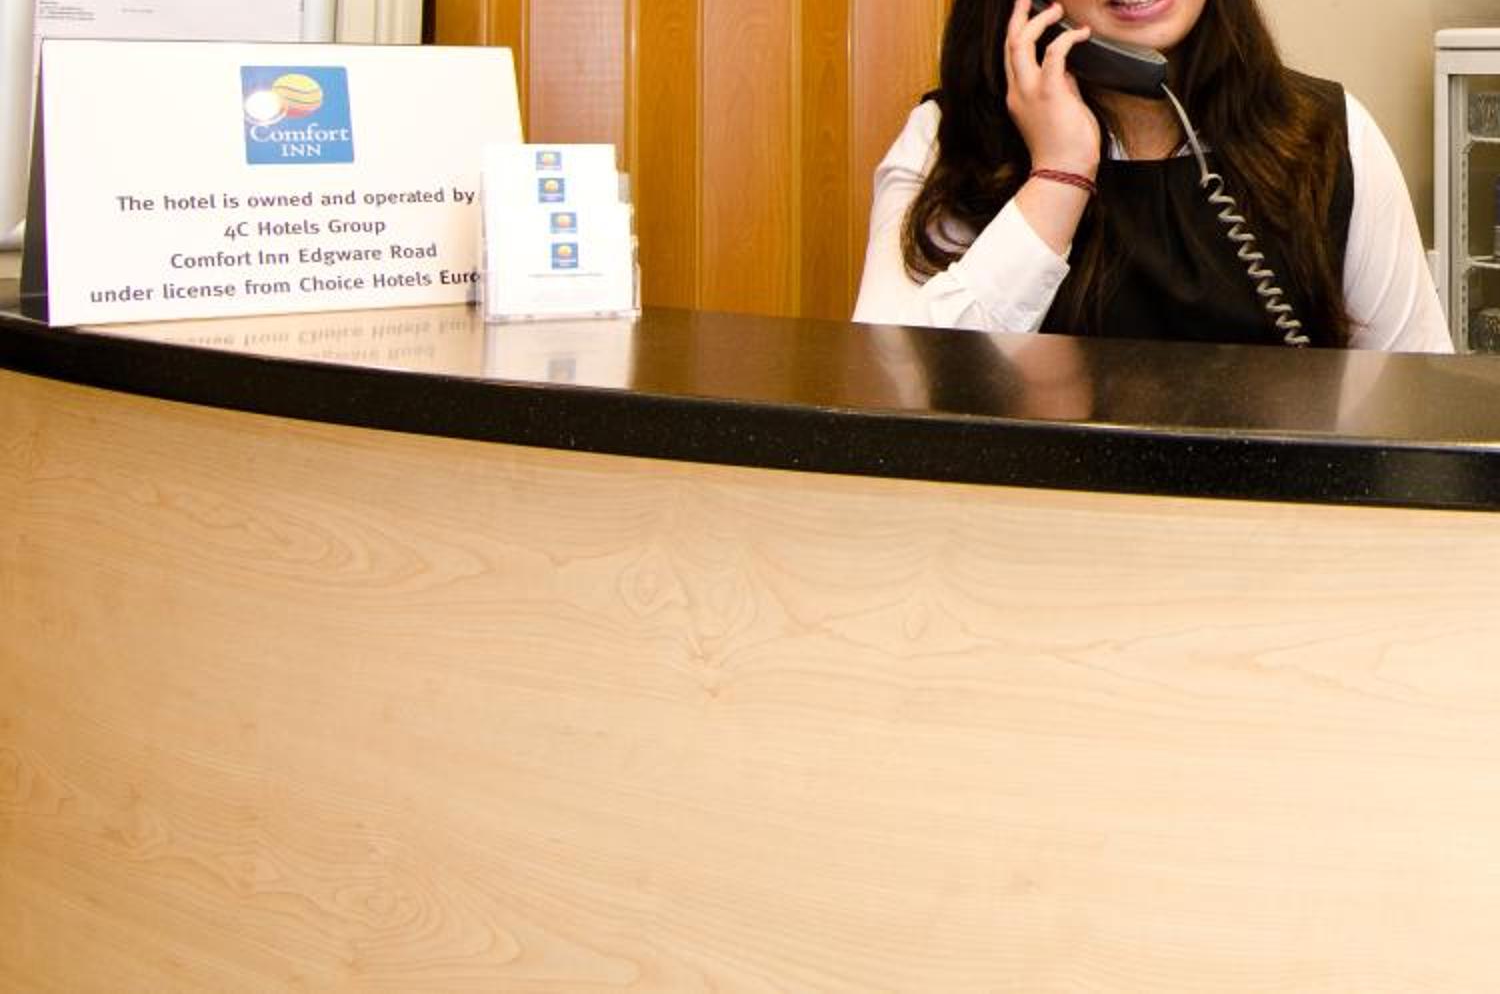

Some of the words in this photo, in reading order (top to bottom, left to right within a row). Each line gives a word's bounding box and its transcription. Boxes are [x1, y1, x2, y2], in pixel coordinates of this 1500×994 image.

[250, 122, 350, 142] Comfort
[280, 143, 321, 157] INN
[117, 195, 155, 211] The
[163, 193, 216, 210] hotel
[223, 193, 239, 208] is
[247, 191, 313, 207] owned
[321, 190, 356, 205] and
[363, 187, 445, 207] operated
[453, 187, 476, 205] by
[223, 221, 249, 242] 4C
[258, 220, 321, 236] Hotels
[328, 219, 386, 235] Group
[170, 251, 252, 269] Comfort
[258, 250, 289, 265] Inn
[299, 247, 382, 266] Edgware
[390, 242, 438, 259] Road
[91, 285, 154, 304] under
[162, 282, 236, 300] license
[245, 279, 291, 295] from
[300, 275, 365, 293] Choice
[372, 271, 432, 288] Hotels
